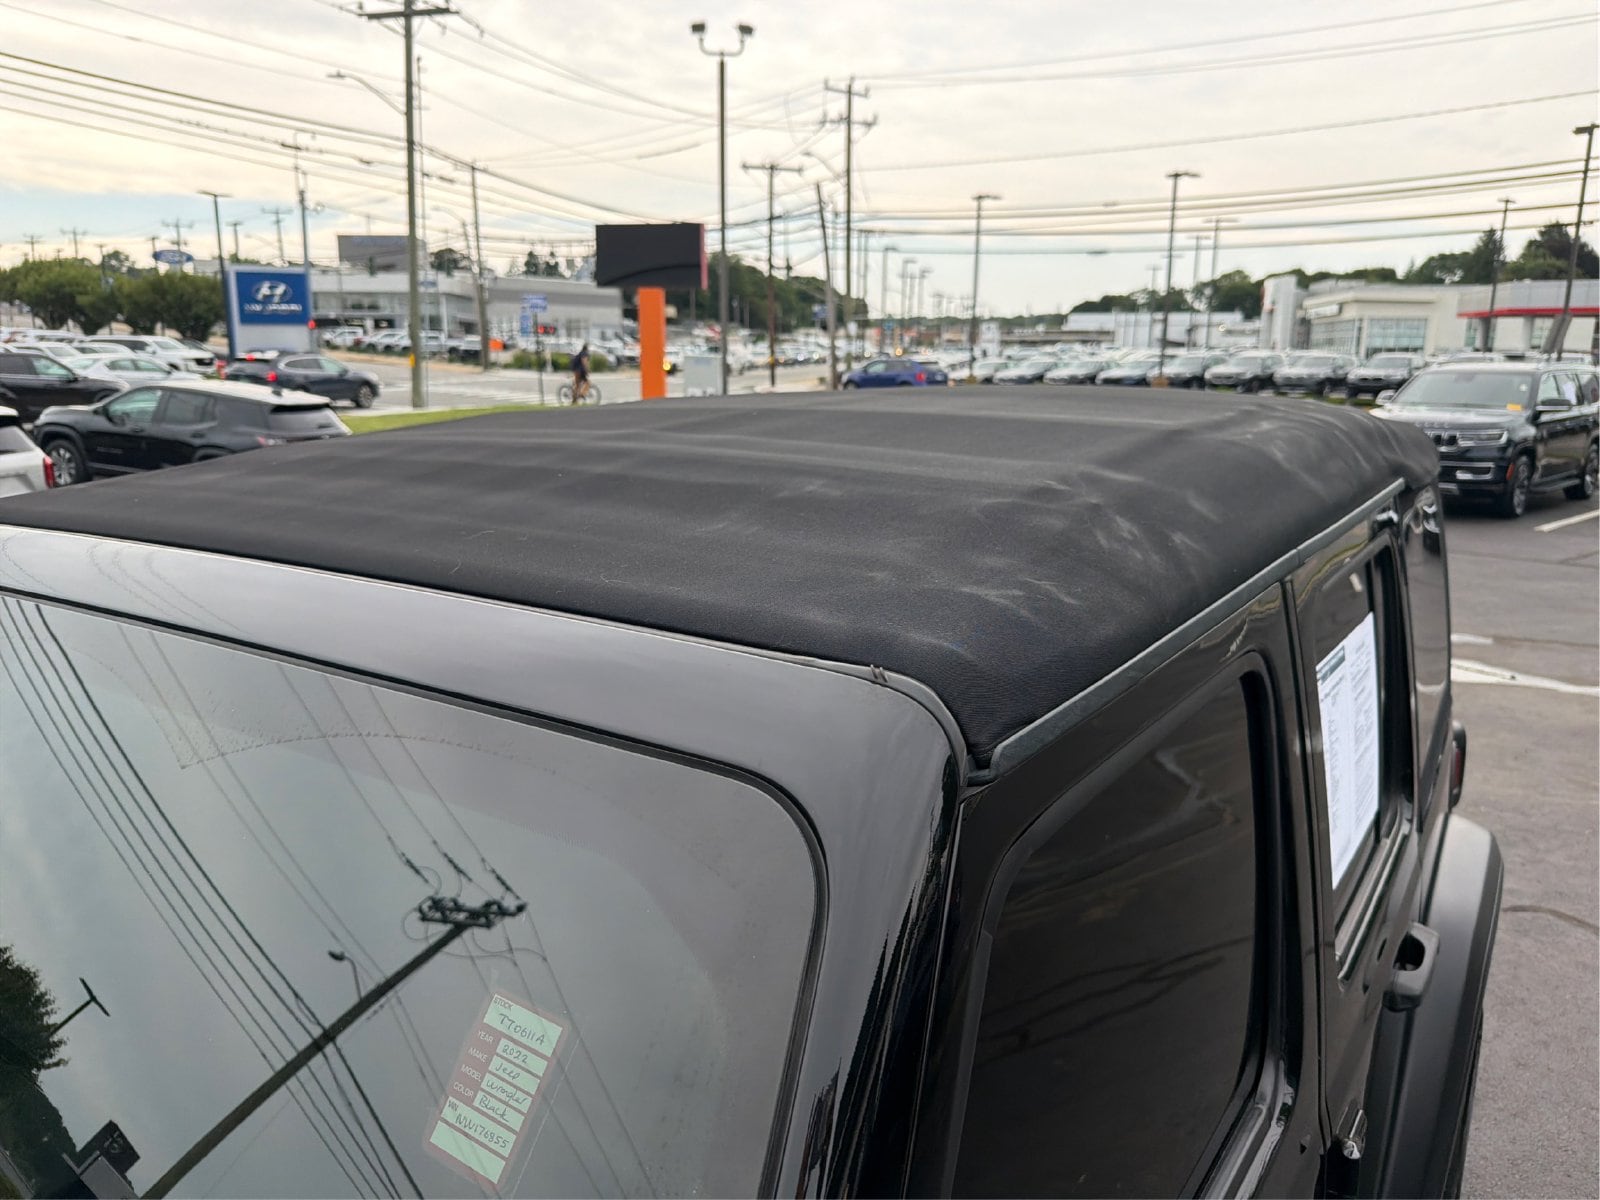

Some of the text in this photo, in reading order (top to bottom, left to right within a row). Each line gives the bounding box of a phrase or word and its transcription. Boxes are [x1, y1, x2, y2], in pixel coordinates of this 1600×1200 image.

[494, 997, 513, 1011] STOCK
[478, 1030, 494, 1044] YEAR
[468, 1047, 488, 1063] MAKE
[502, 1044, 529, 1065] 2022
[461, 1063, 482, 1082] MODEL
[453, 1081, 474, 1099] COLOR
[479, 1094, 509, 1123] Black
